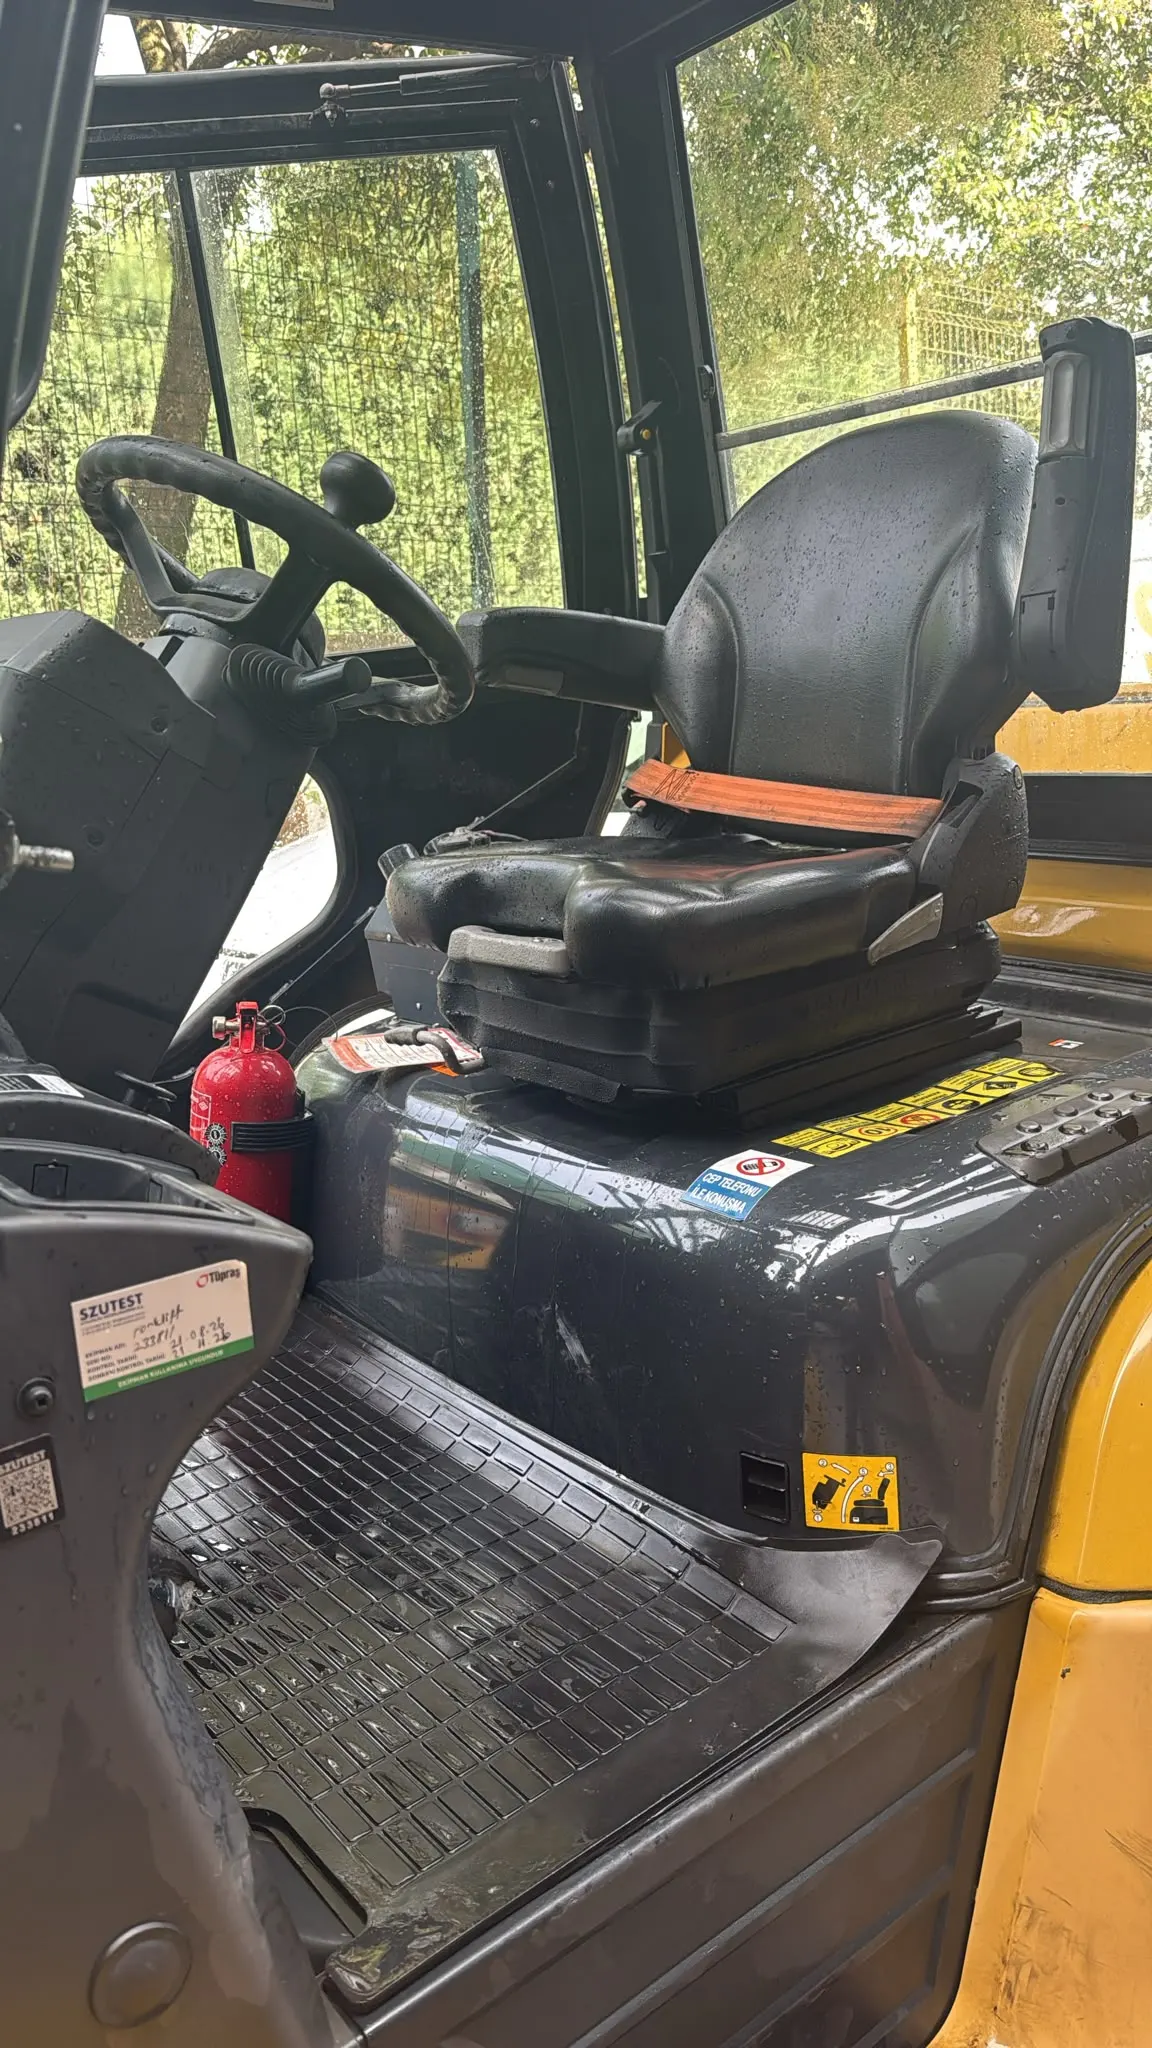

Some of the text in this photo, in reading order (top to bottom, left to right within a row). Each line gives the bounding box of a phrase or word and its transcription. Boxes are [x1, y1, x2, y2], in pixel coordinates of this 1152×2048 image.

[702, 1172, 763, 1198] CEP TELEFONU
[690, 1184, 747, 1214] İLE KONUŞMA
[208, 1268, 241, 1284] Tüpraş
[79, 1292, 144, 1321] SZUTEST
